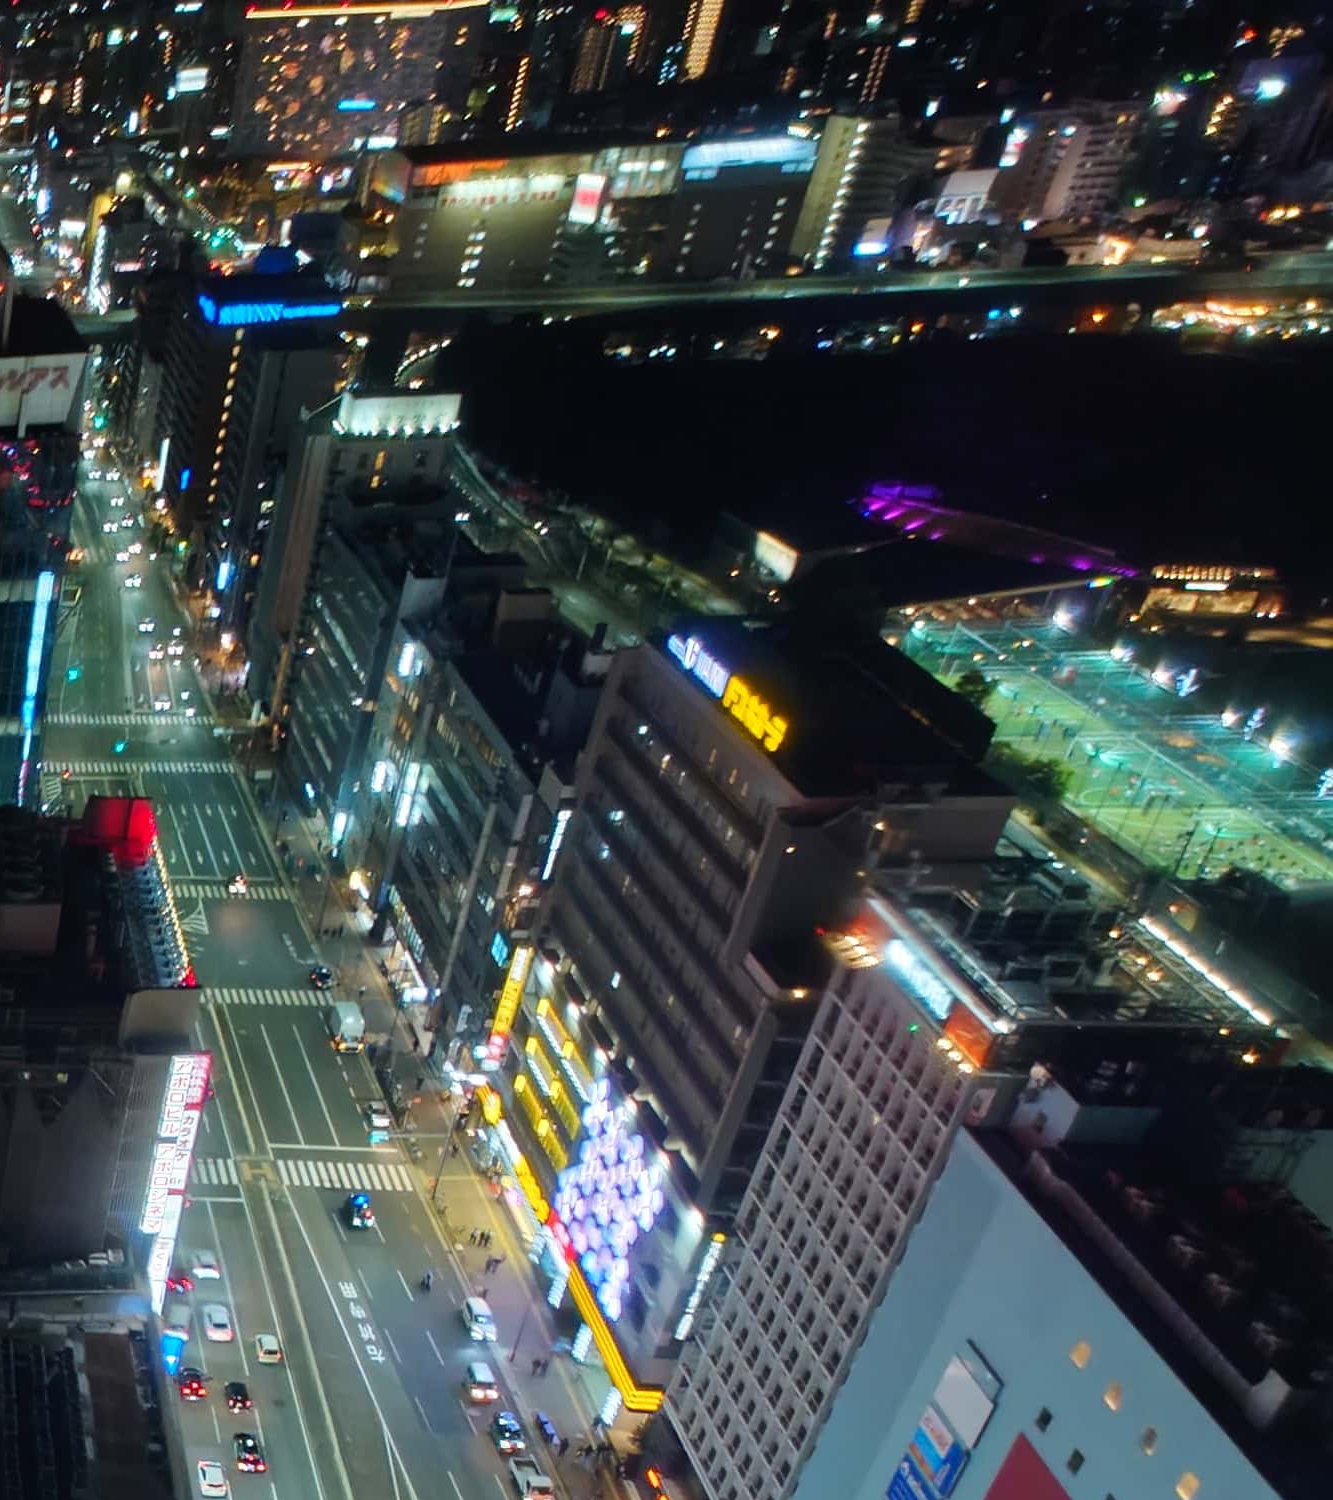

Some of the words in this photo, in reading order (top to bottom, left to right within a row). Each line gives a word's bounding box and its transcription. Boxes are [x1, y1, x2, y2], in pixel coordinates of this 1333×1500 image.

[165, 1060, 190, 1134] アポロビル
[176, 1115, 195, 1160] カラオケ
[144, 1144, 175, 1229] アポロシネマ
